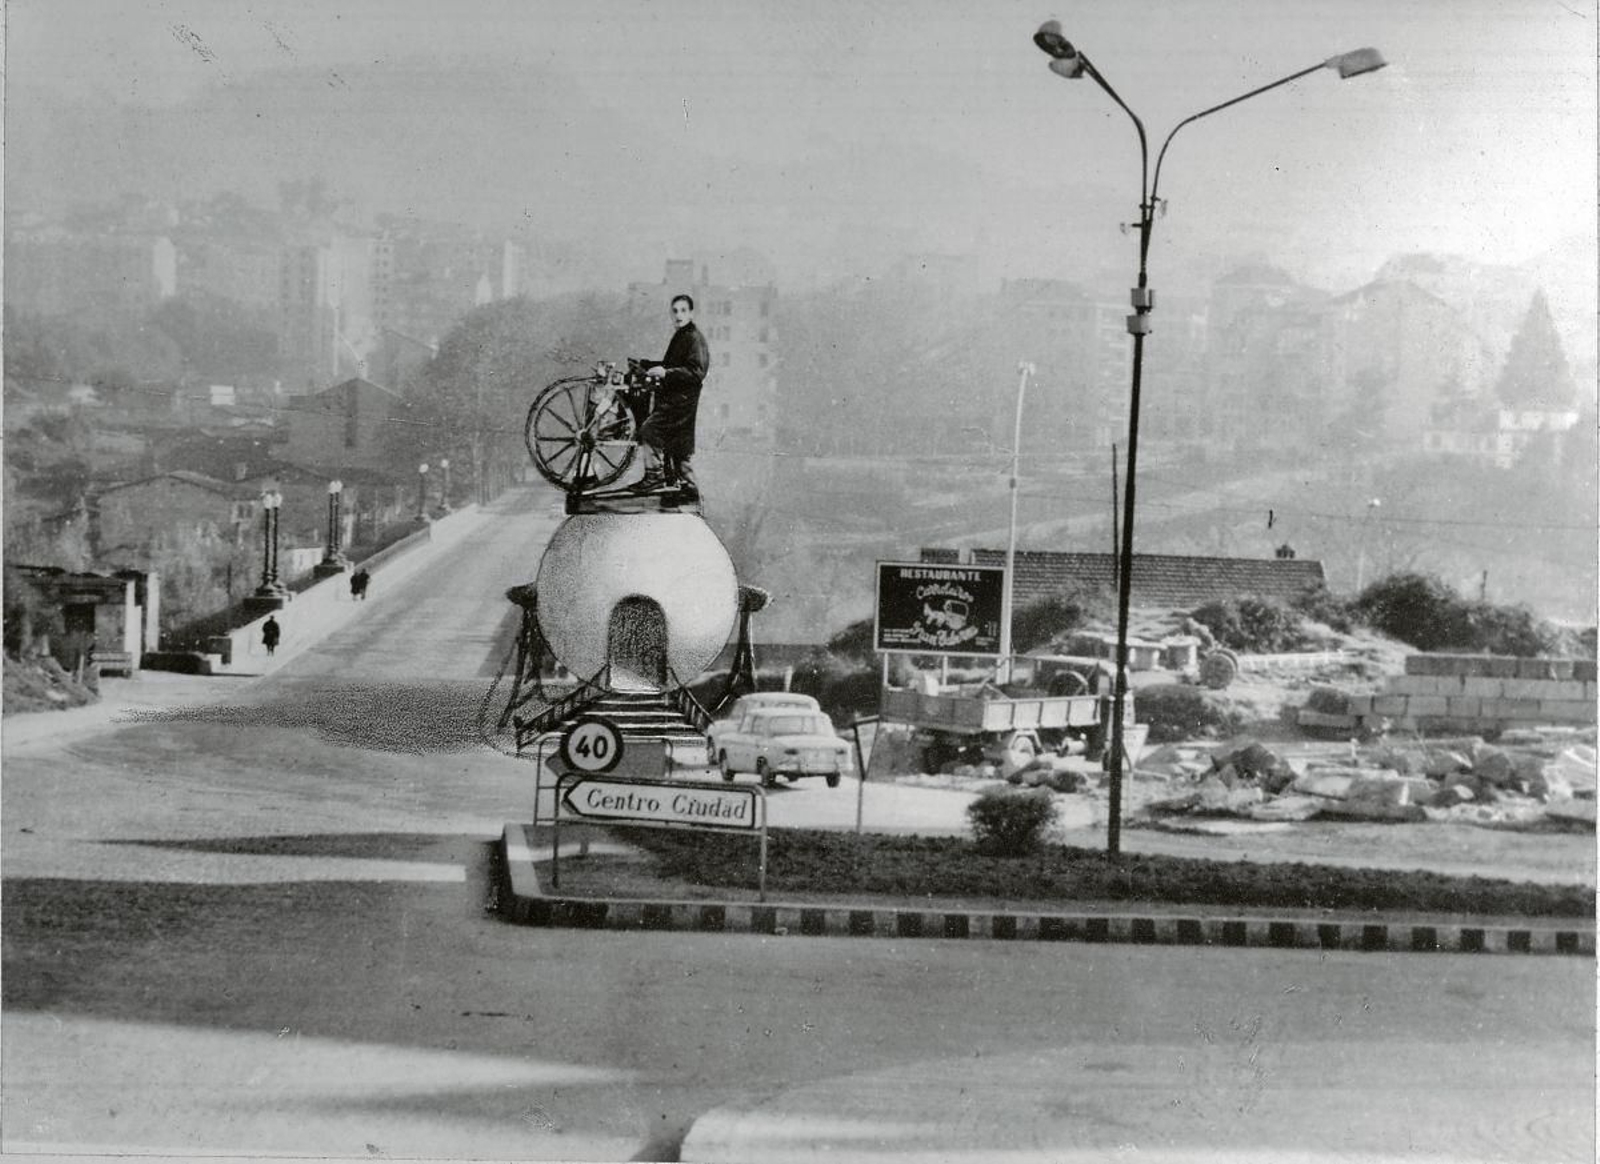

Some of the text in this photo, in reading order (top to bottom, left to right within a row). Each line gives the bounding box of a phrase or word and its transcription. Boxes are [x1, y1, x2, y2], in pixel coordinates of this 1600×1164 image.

[900, 568, 981, 581] RESTAURANTE
[575, 735, 608, 759] 40
[586, 788, 748, 819] Centro Ciudad
